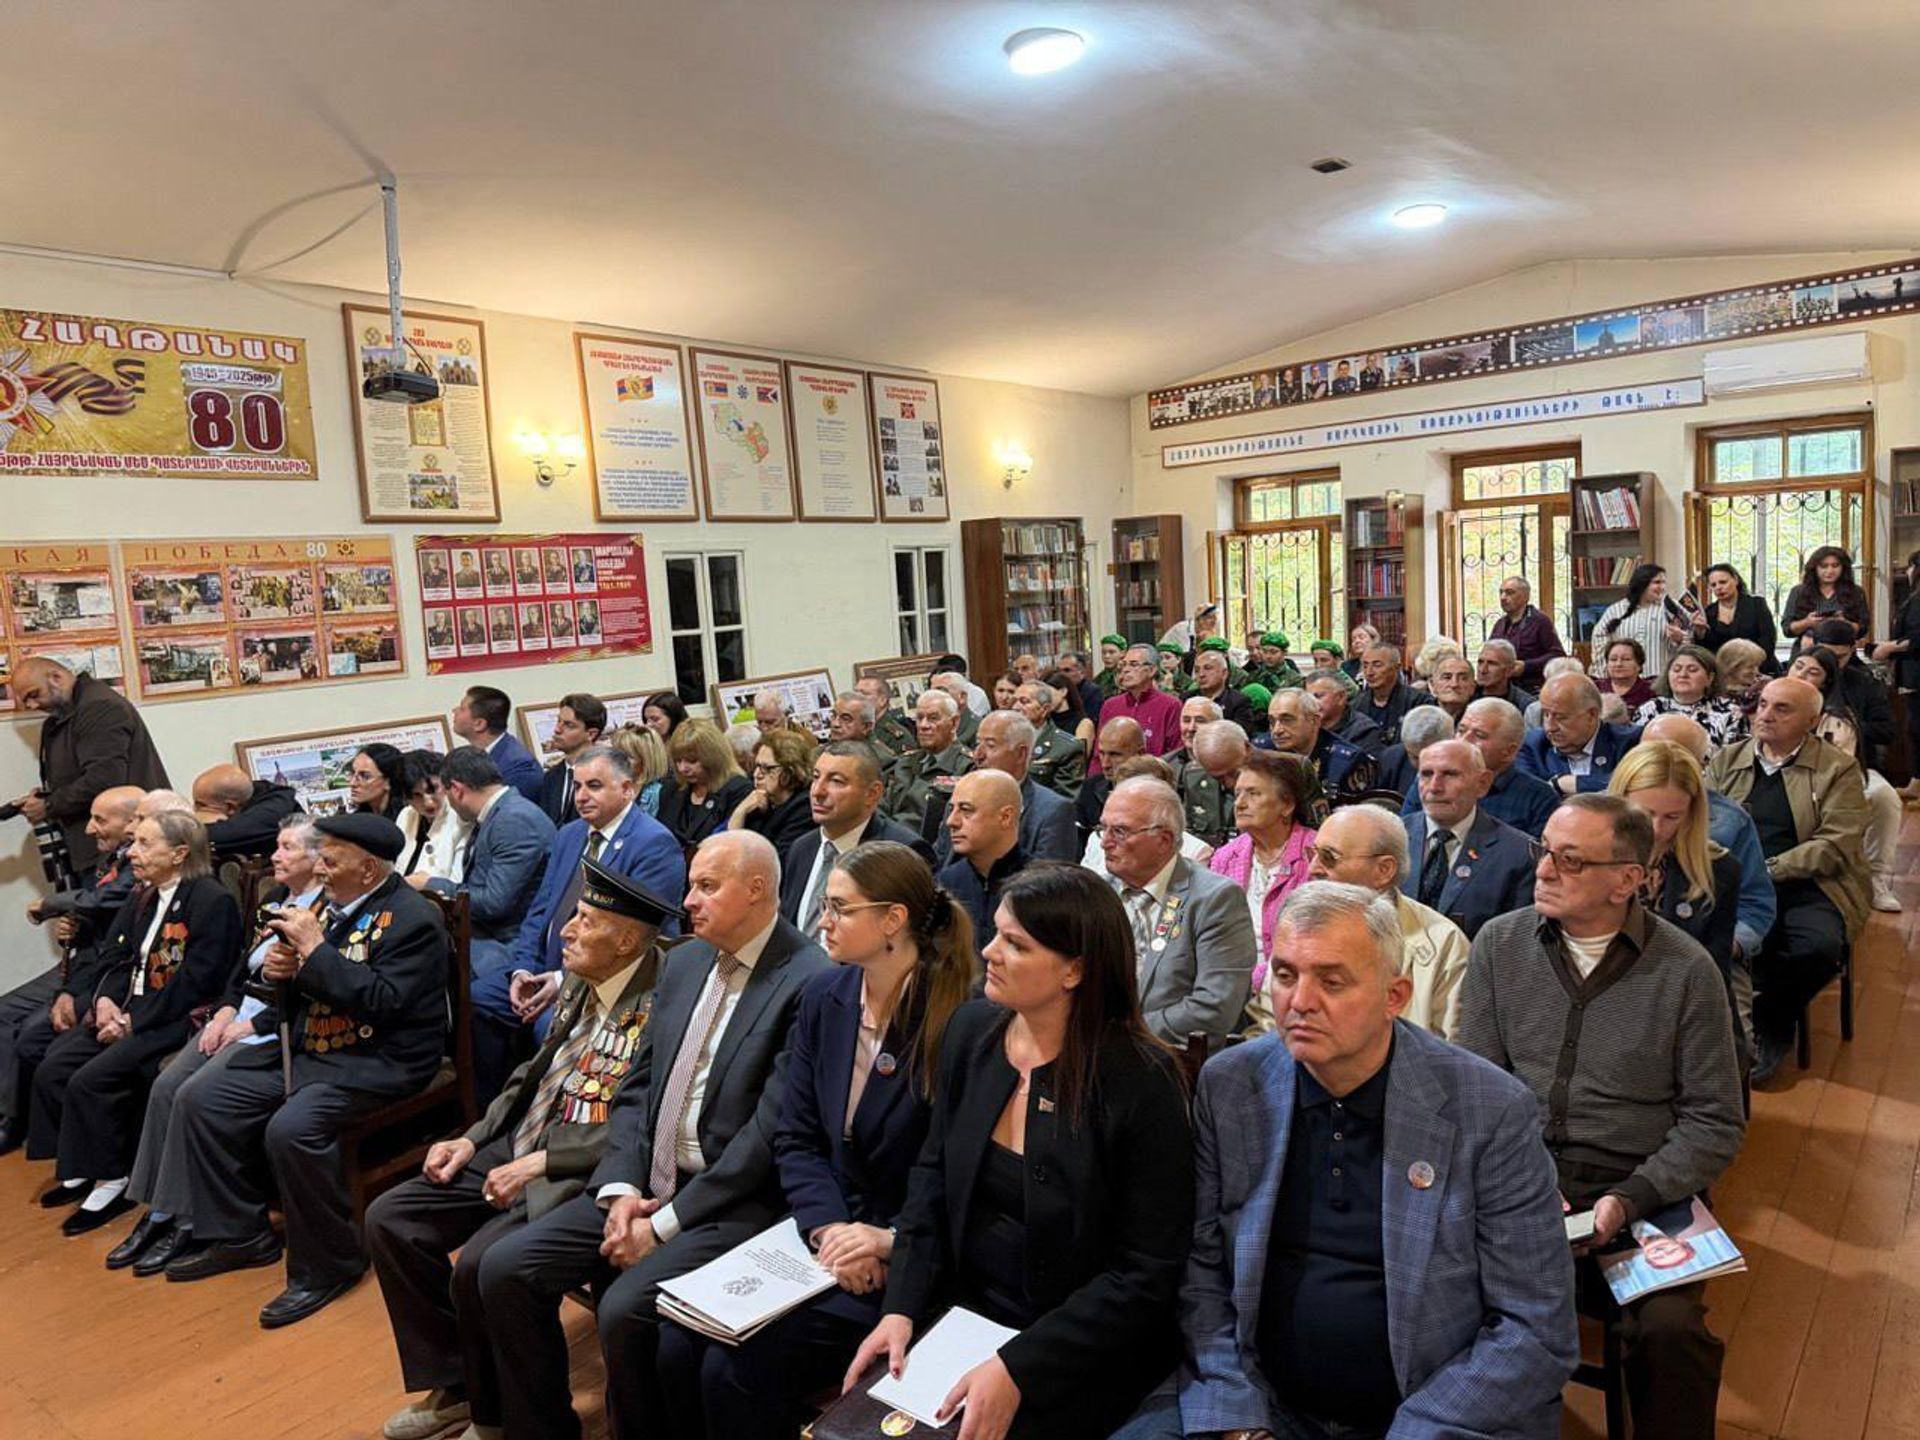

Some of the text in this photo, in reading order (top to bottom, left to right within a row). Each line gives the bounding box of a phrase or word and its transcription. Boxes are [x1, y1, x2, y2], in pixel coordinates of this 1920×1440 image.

[19, 317, 298, 365] ՀԱՂԹԱՆԱԿ
[188, 388, 285, 454] 80
[37, 452, 122, 468] ՀԱՅՐԵՆԱԿԱՆ
[124, 454, 149, 468] ՄԵԾ
[151, 456, 224, 470] ՊԱՏԵՐԱԶՄԻ
[225, 458, 310, 473] ՎԵՏԵՐԱՆՆԵՐԻՆ
[14, 548, 90, 564] КАЯ
[144, 544, 288, 562] ПОБЕДА
[305, 542, 327, 558] 80
